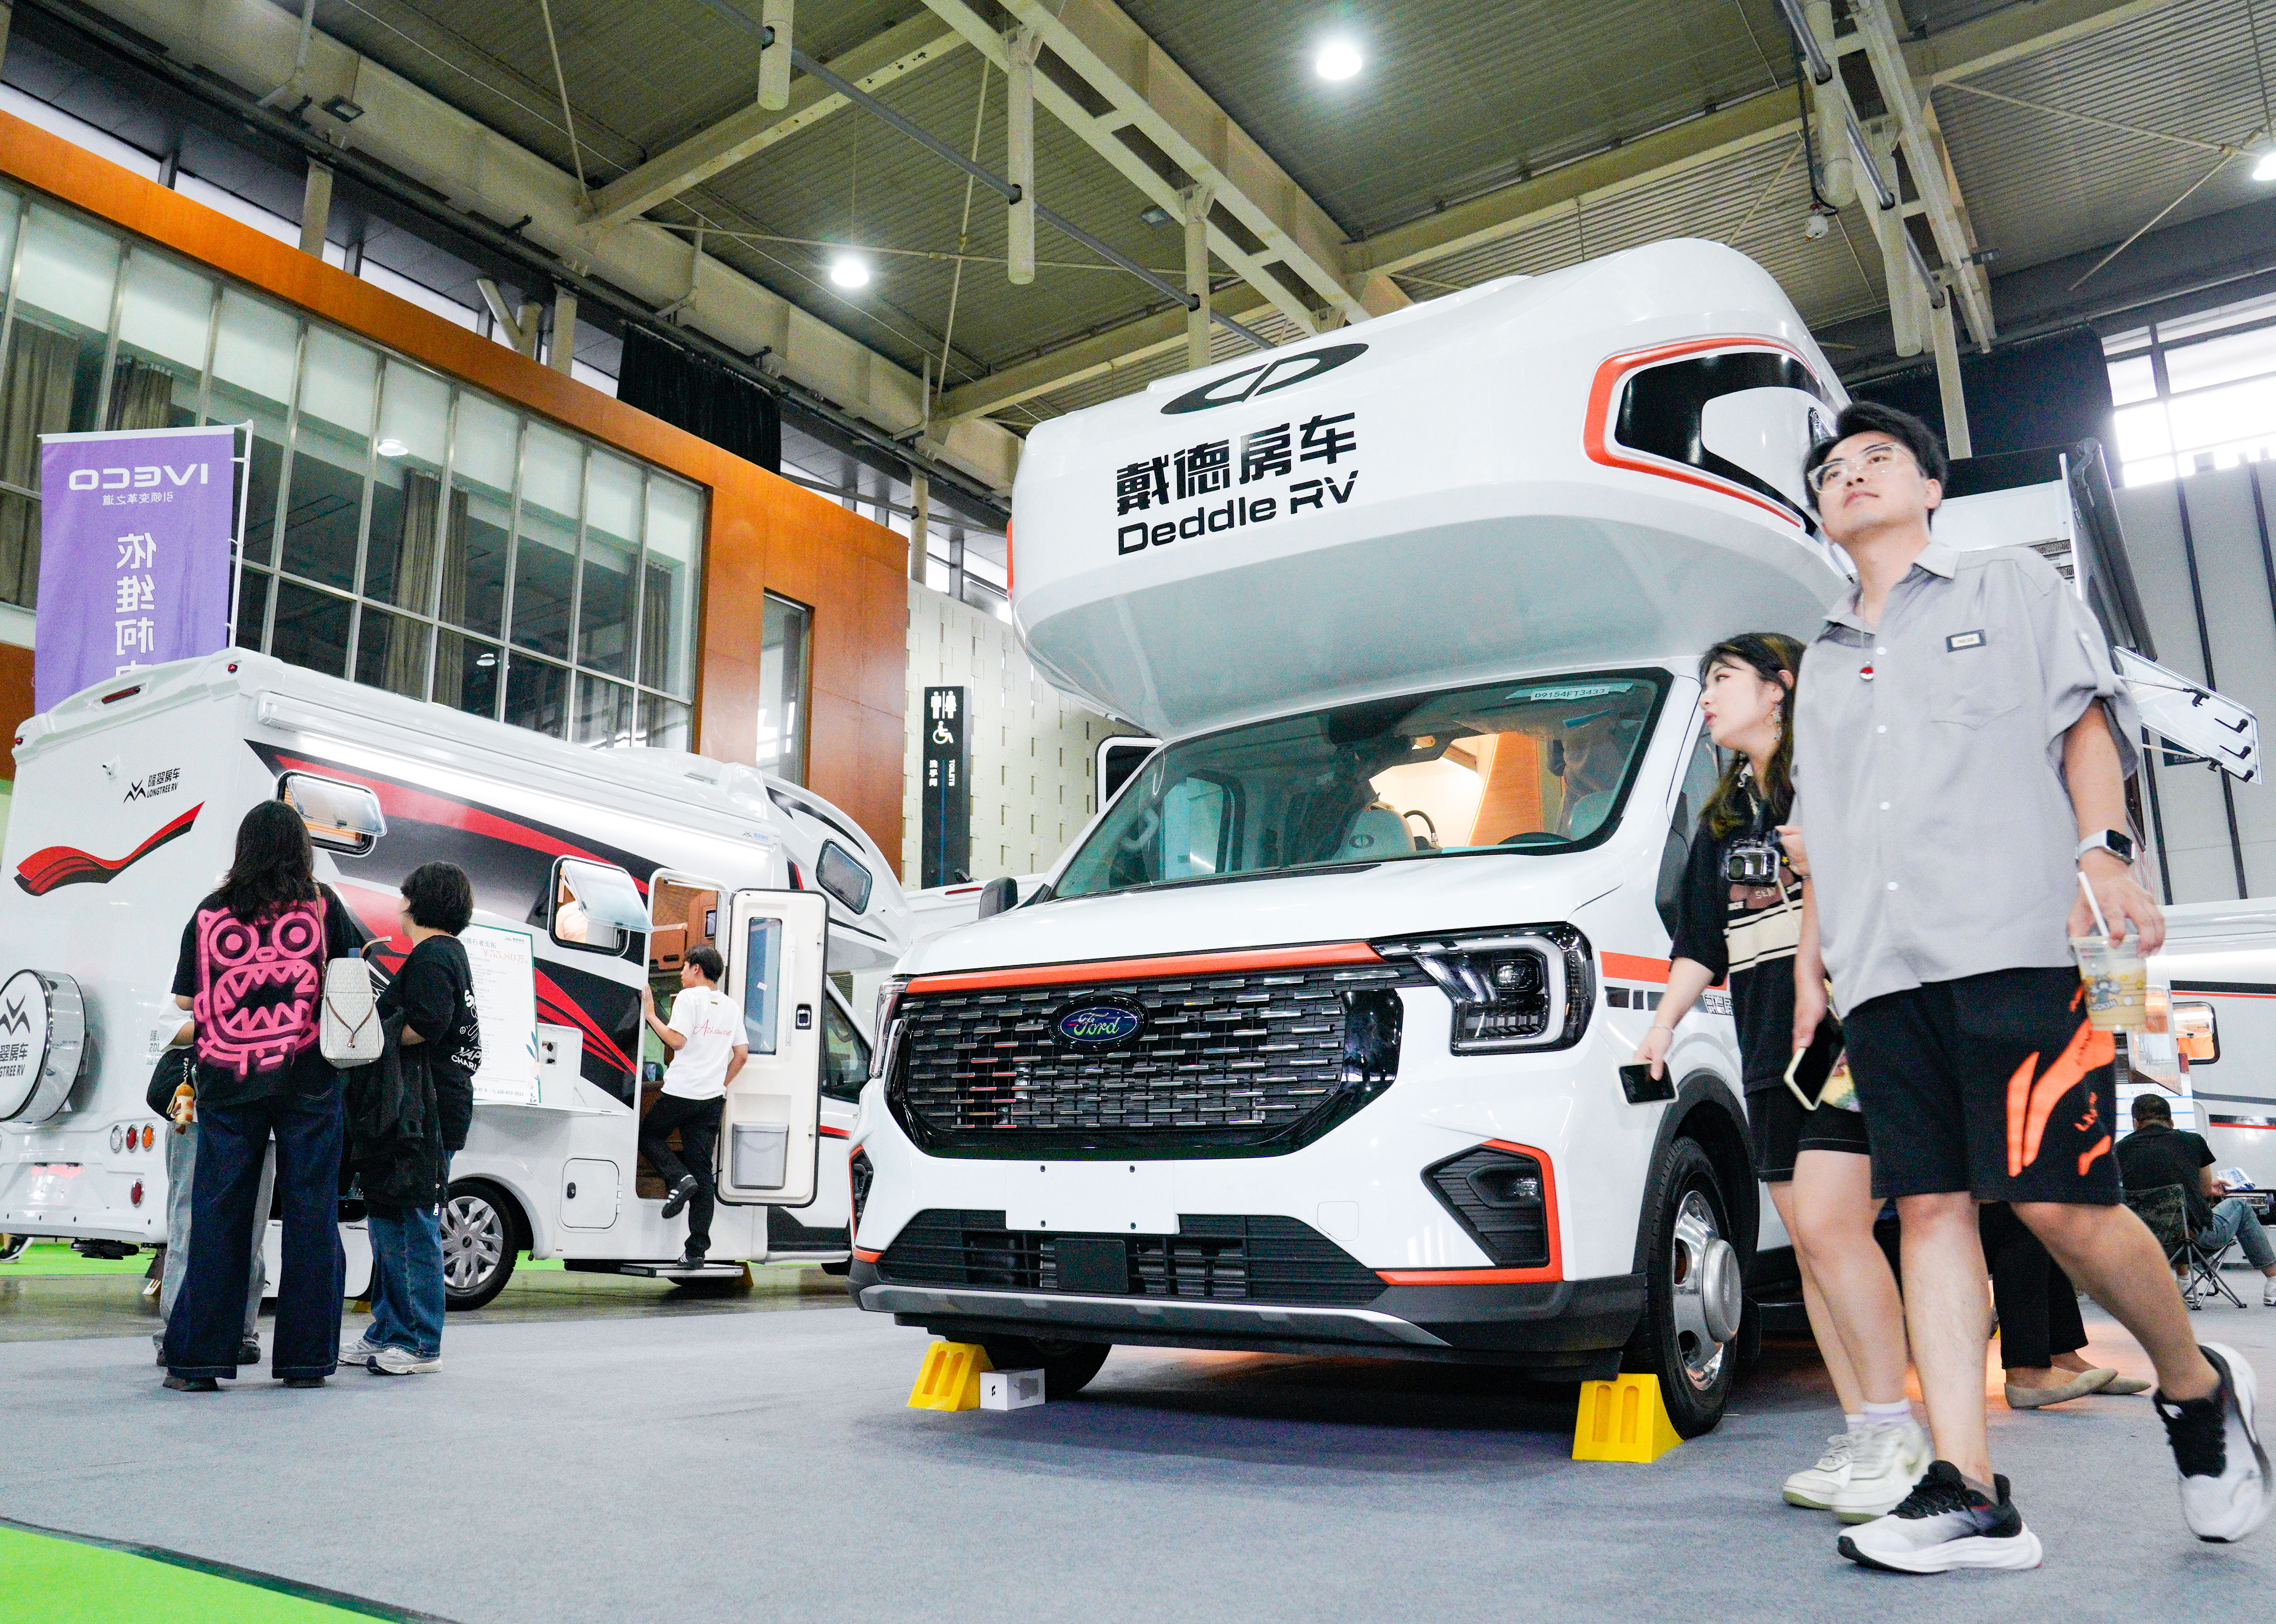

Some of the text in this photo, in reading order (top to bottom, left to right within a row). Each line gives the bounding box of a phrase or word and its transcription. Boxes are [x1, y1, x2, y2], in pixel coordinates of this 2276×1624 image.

[1117, 412, 1357, 516] 戴德房车
[1118, 470, 1359, 556] Deddle RV
[1534, 688, 1605, 698] D9154FT3433
[147, 782, 178, 798] LONGTREE RV
[1073, 1012, 1121, 1036] Ford
[0, 1043, 29, 1062] 翠房车
[149, 1043, 160, 1052] ZDL
[0, 1064, 25, 1077] GTREE RV
[451, 1054, 480, 1072] CHARL
